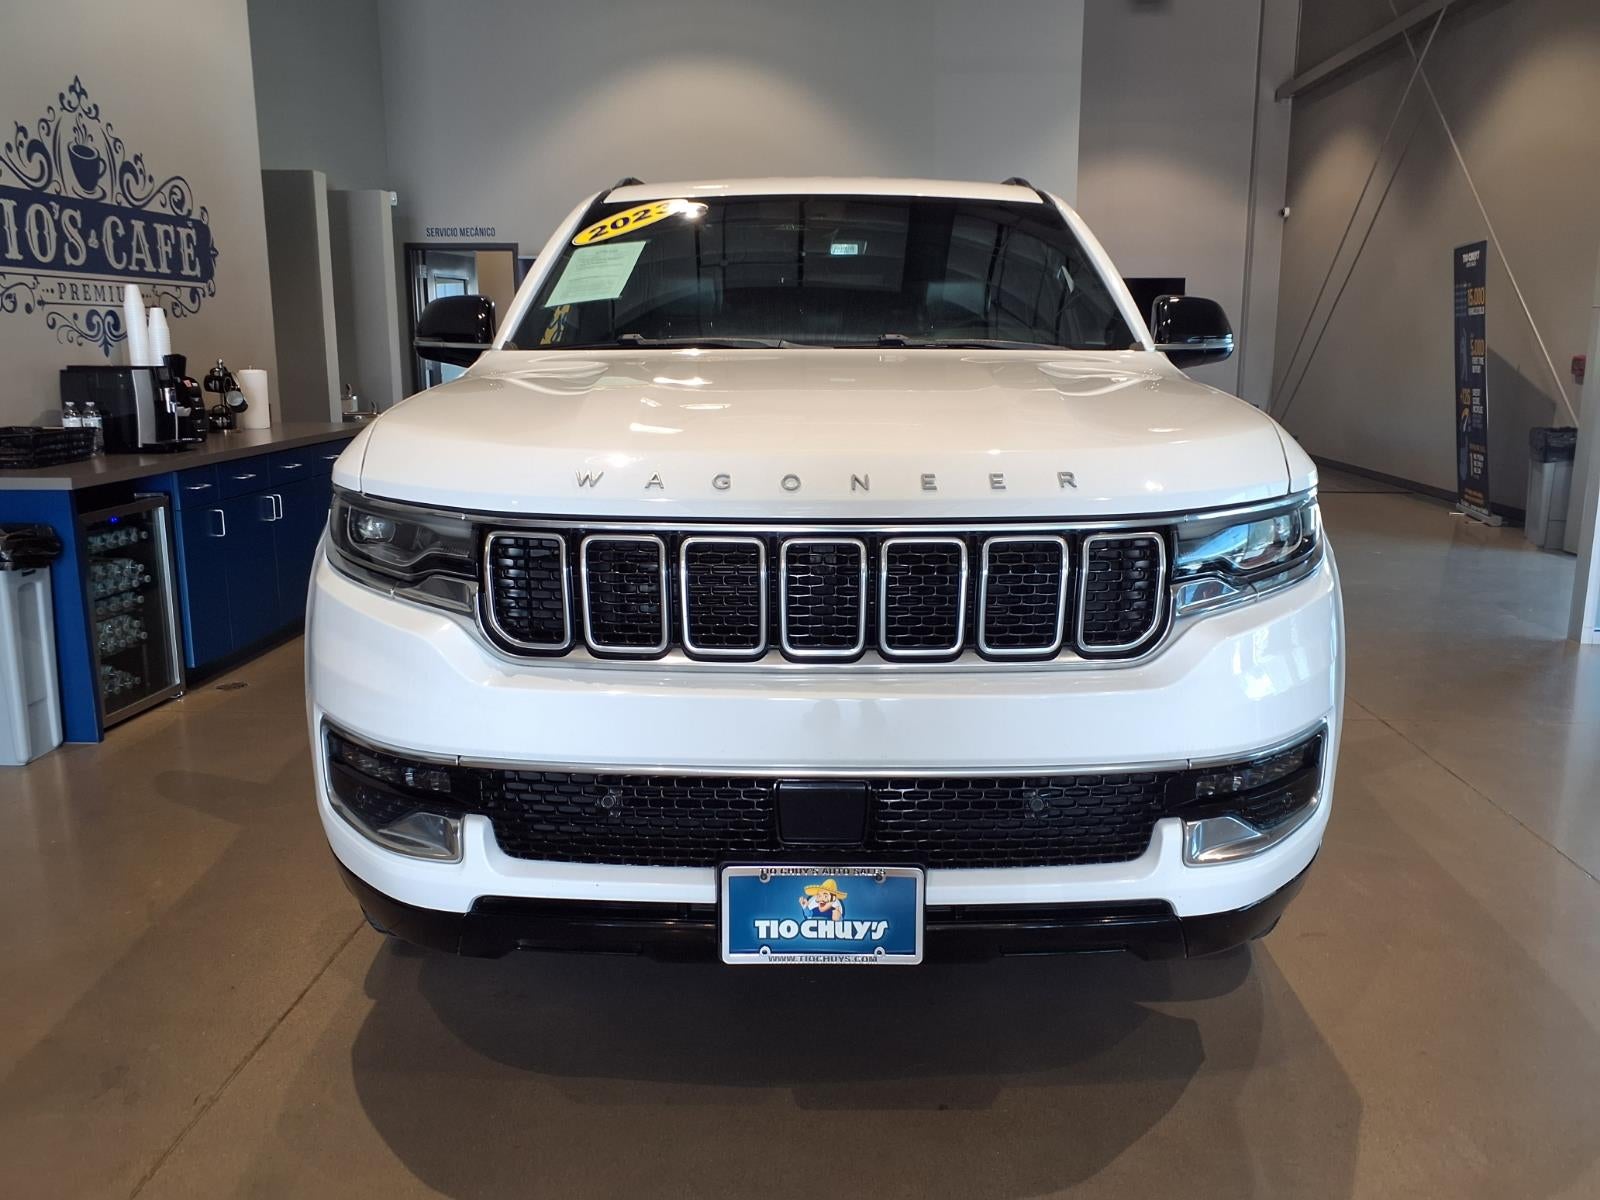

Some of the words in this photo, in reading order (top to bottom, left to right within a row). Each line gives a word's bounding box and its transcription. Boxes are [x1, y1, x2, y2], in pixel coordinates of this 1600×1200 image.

[0, 199, 87, 267] IO'S
[426, 227, 458, 238] SERVICIO
[57, 281, 126, 304] PREMIU
[575, 469, 1079, 492] WAGONEER
[822, 867, 850, 876] AUTO
[853, 867, 886, 876] SALES
[768, 955, 878, 963] WWW.TIOCHUYS.COM
